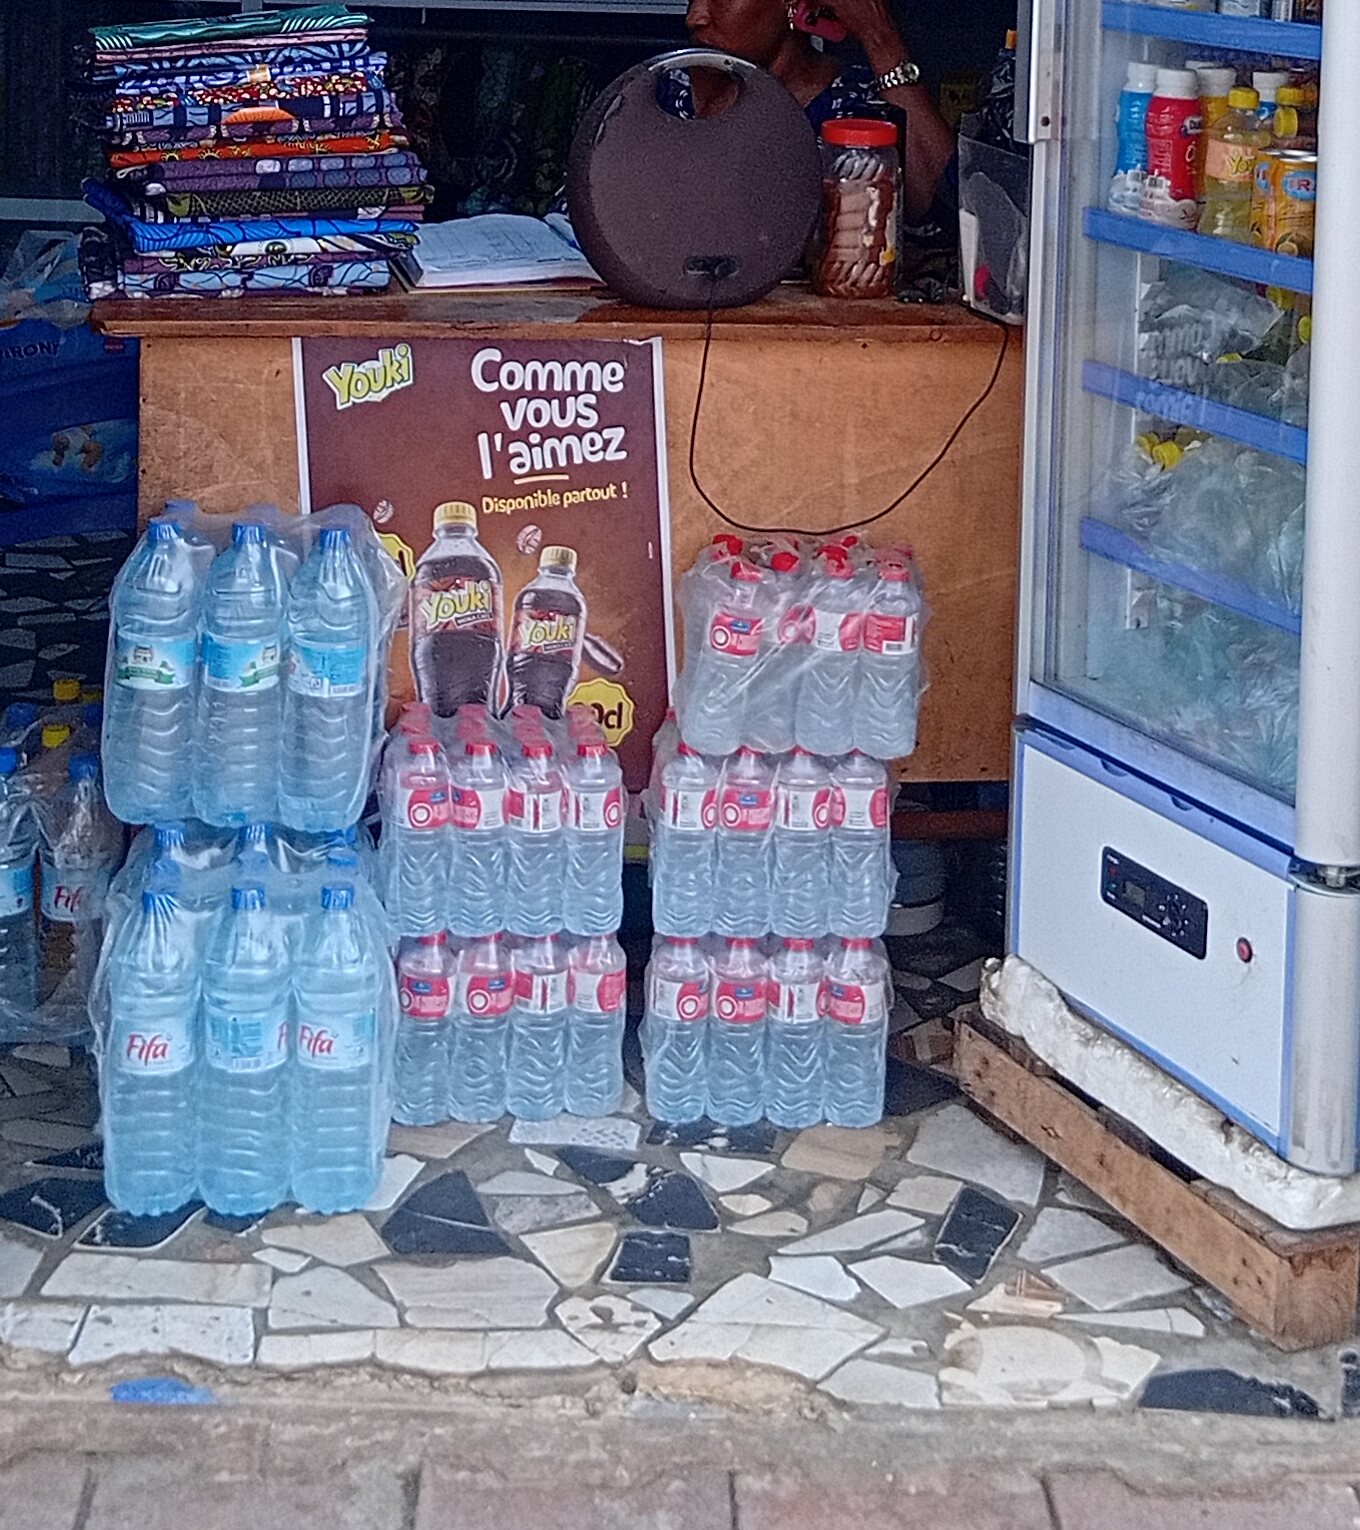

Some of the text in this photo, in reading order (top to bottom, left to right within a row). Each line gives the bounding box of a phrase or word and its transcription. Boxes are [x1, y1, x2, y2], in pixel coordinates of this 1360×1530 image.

[323, 342, 415, 410] Youki
[471, 347, 625, 393] Comme
[500, 393, 599, 431] vous
[477, 426, 628, 480] l'aimez
[482, 482, 629, 516] Disponible partout !
[420, 580, 493, 630] Youki
[519, 614, 576, 649] Youki
[126, 1032, 170, 1061] Fifa
[299, 1027, 339, 1058] Fifa
